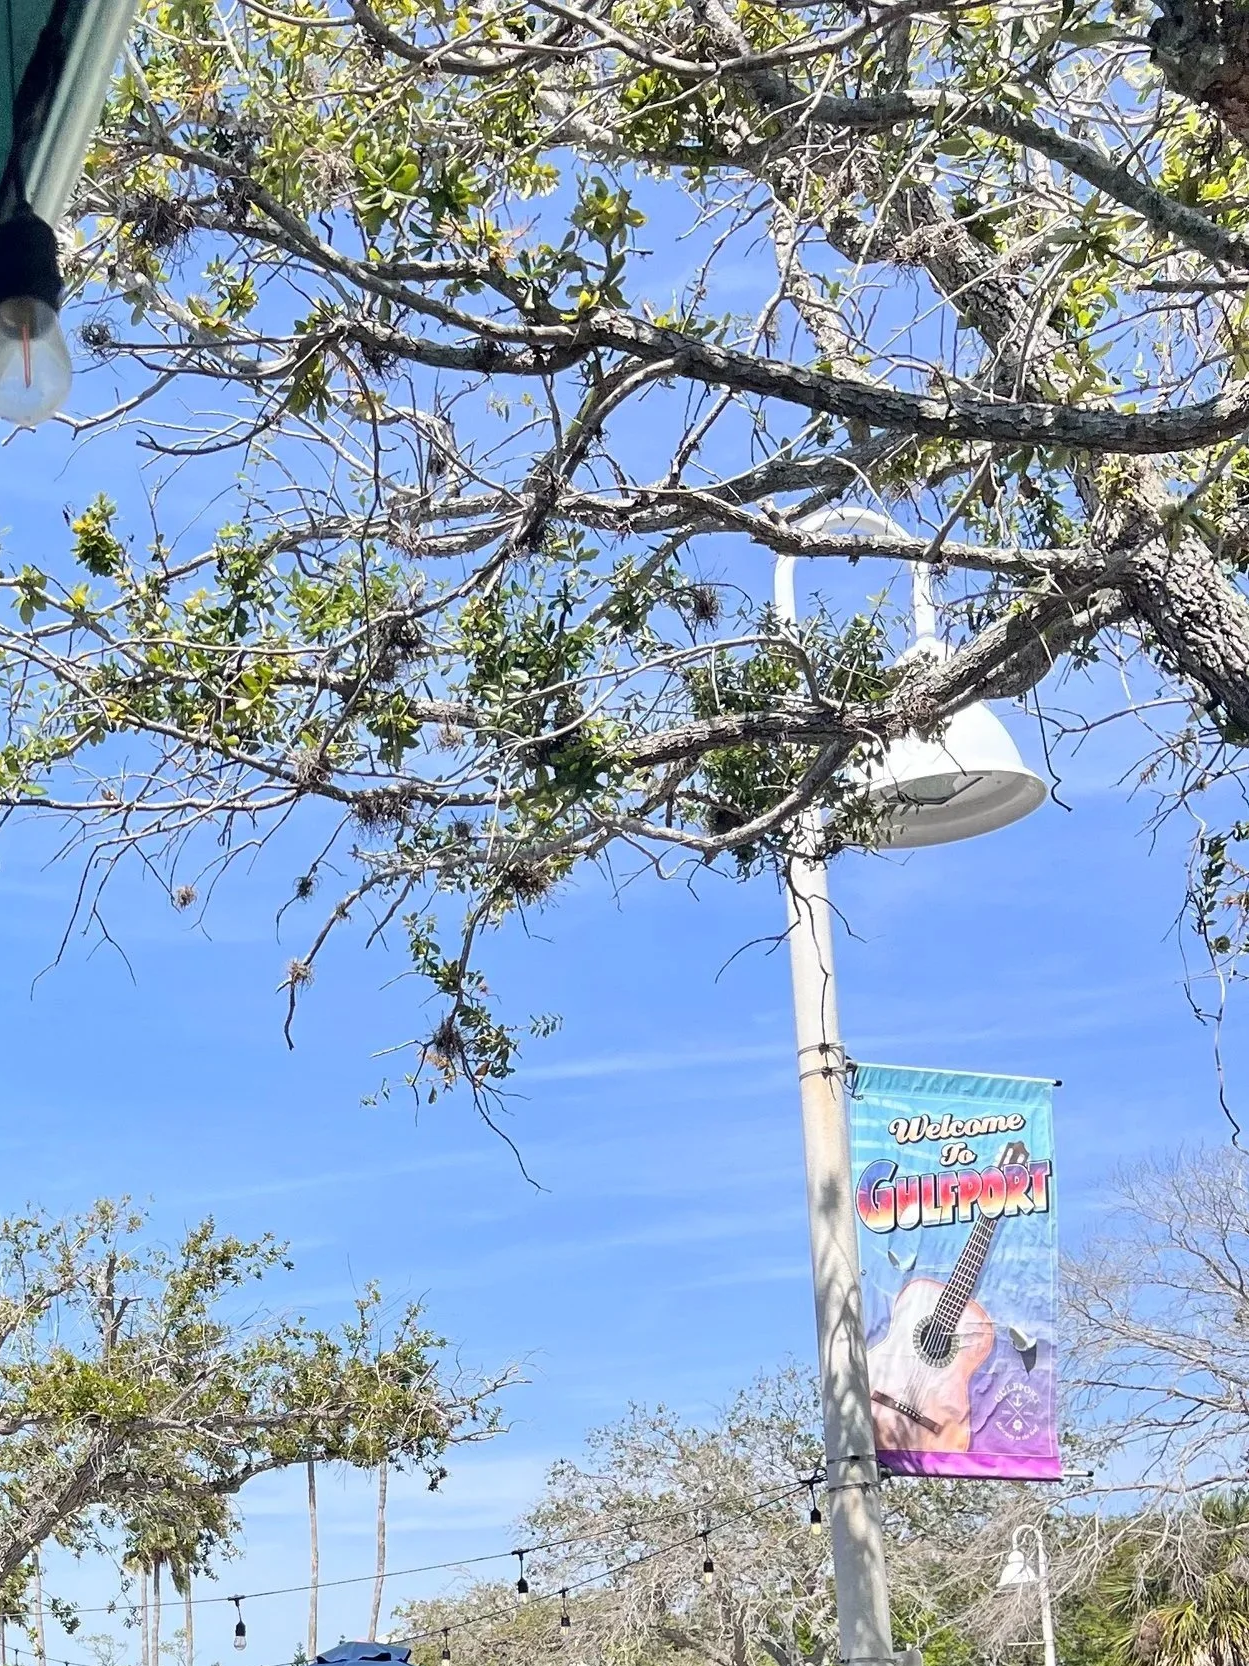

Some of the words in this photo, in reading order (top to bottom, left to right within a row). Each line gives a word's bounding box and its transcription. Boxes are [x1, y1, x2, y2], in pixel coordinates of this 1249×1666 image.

[888, 1113, 1026, 1144] Welcome
[939, 1142, 977, 1166] To
[855, 1158, 1053, 1234] GULFPORT
